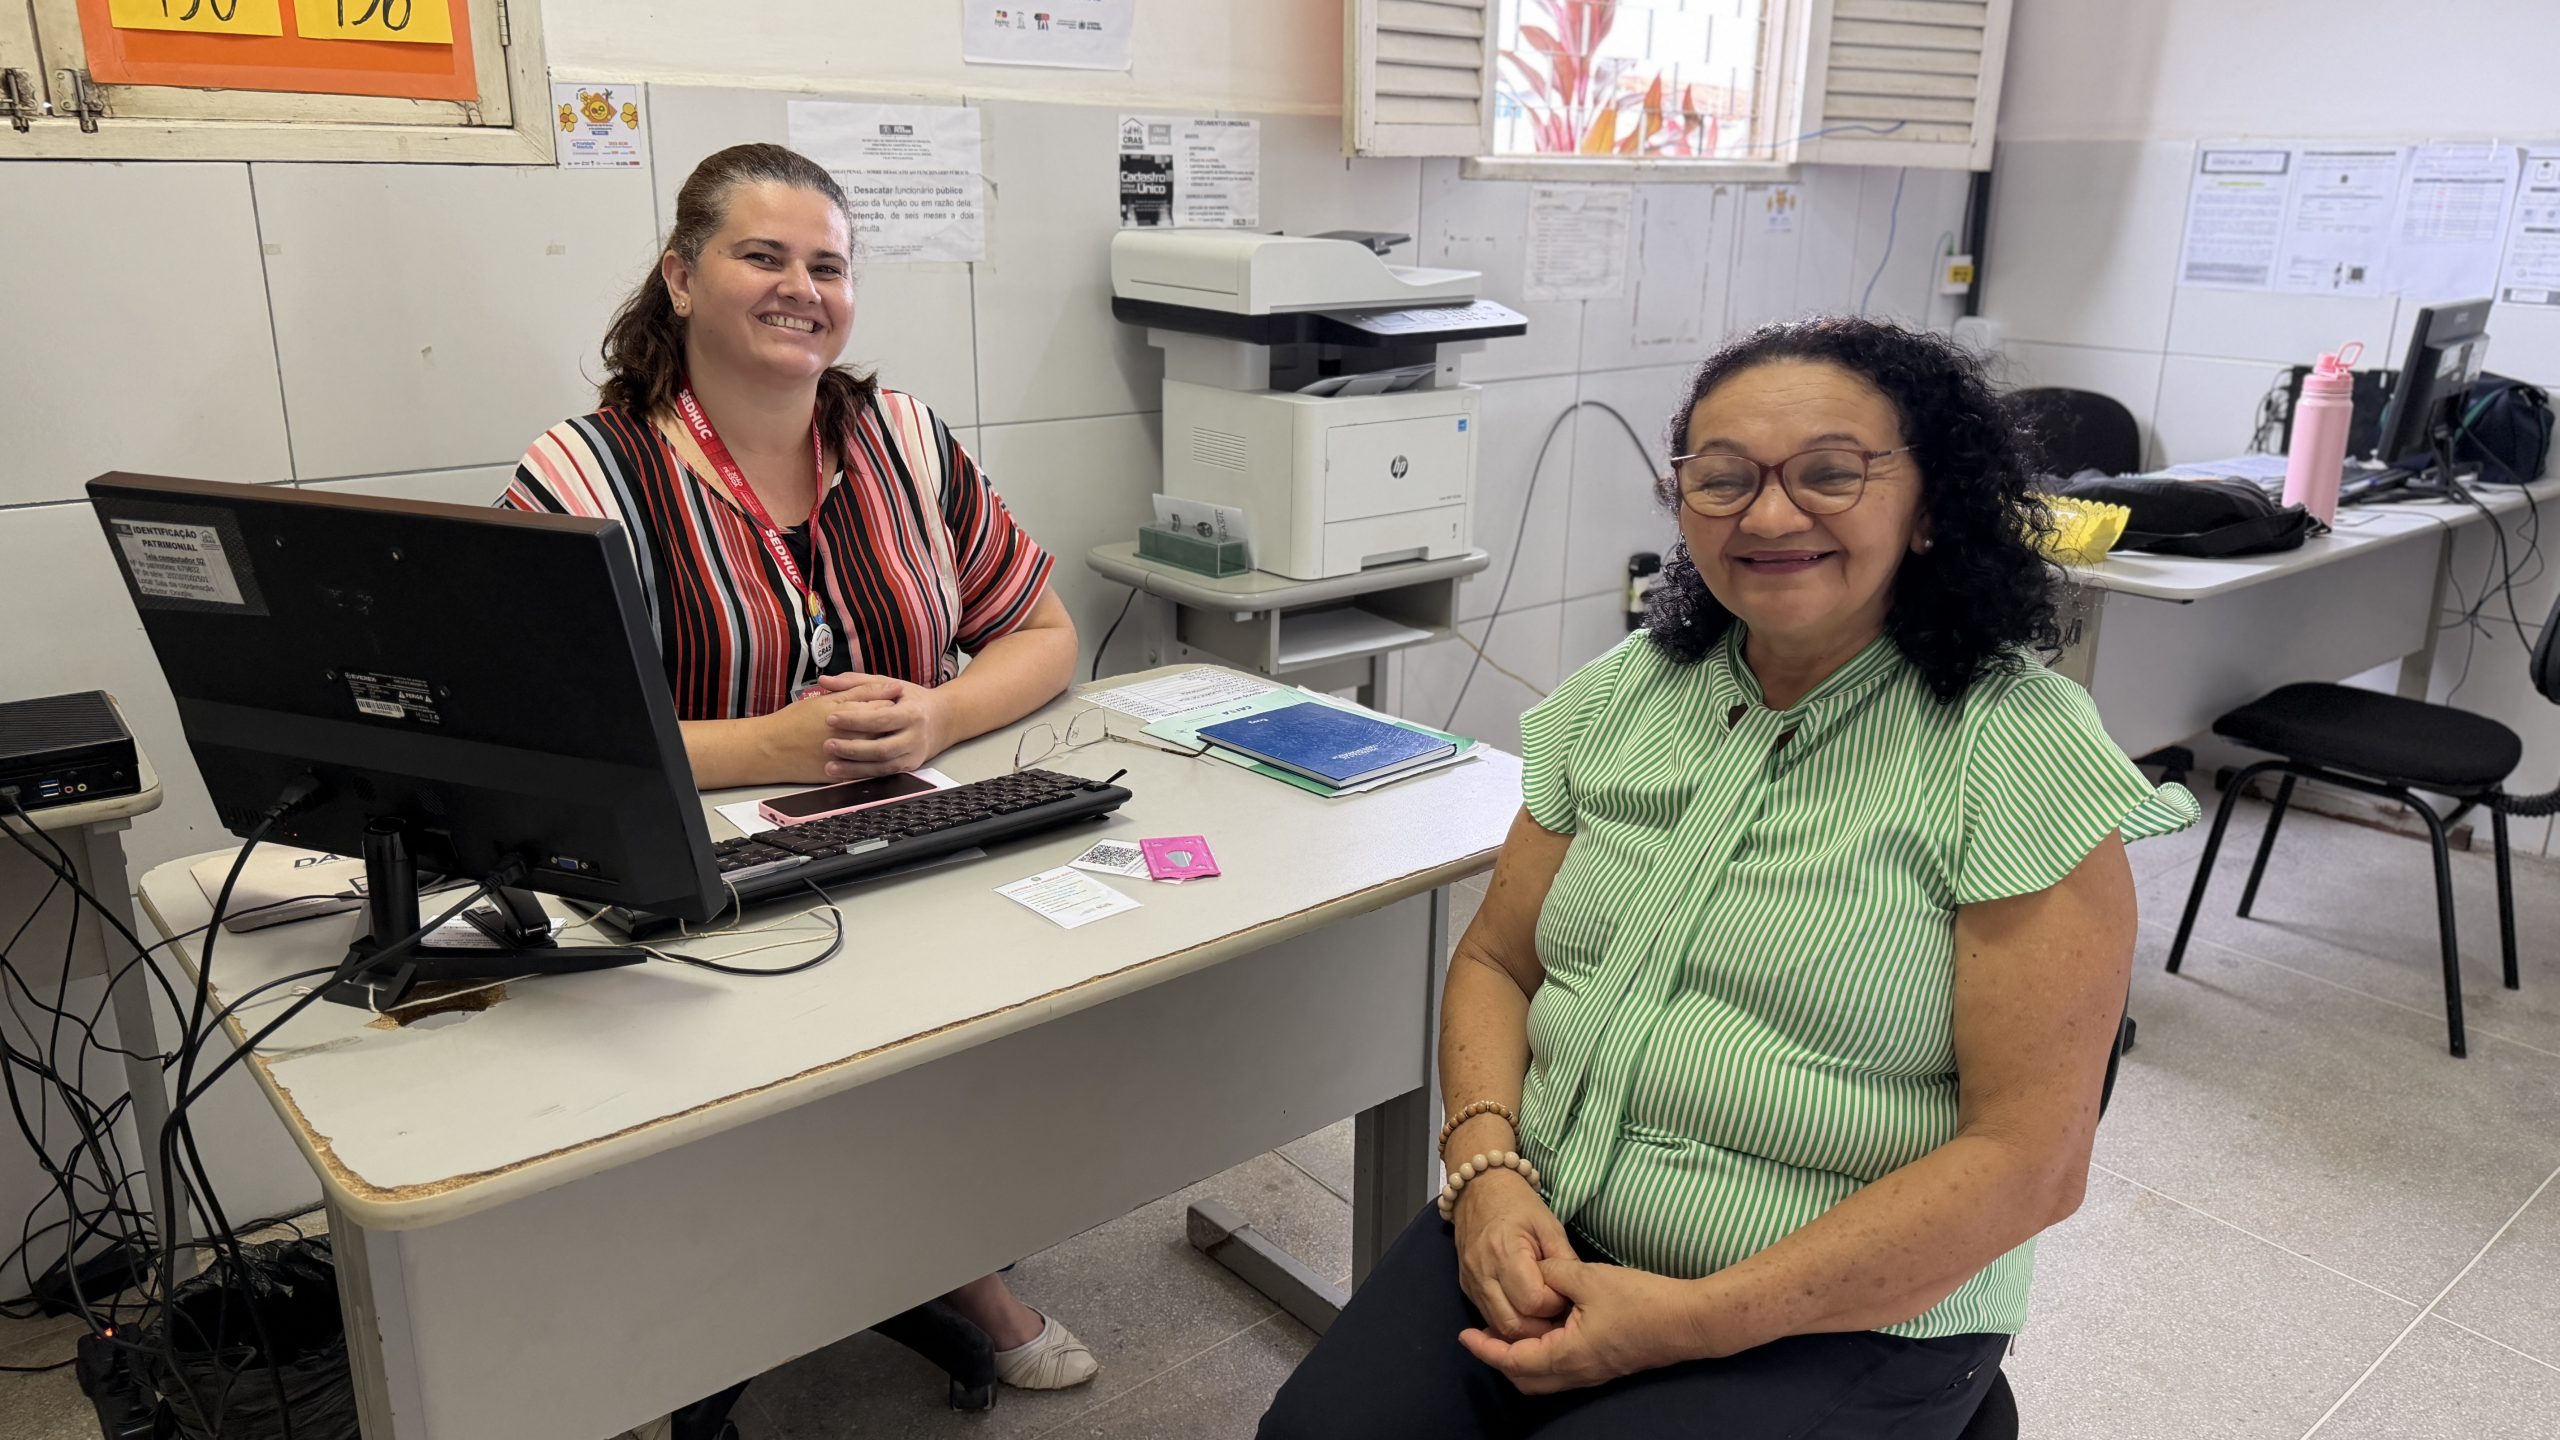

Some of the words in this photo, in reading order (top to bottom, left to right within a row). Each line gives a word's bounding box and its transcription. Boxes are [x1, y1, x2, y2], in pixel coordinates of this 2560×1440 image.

[1123, 136, 1143, 144] CRAS
[1121, 171, 1166, 182] Cadastro
[854, 186, 893, 194] Desacatar
[894, 186, 934, 195] funcionário
[935, 186, 963, 195] público
[1137, 182, 1166, 194] Único
[870, 199, 880, 207] da
[882, 199, 908, 209] função
[934, 199, 954, 207] razão
[890, 212, 900, 220] de
[904, 212, 919, 220] seis
[960, 212, 975, 220] dois
[679, 388, 713, 440] SEDHUC
[1390, 454, 1409, 479] hp
[133, 526, 197, 539] IDENTIFICAÇÃO
[142, 539, 198, 552] PATRIMONIAL
[765, 528, 802, 584] SEDHUC
[817, 644, 832, 658] CRAS
[1222, 705, 1252, 715] CAIXA
